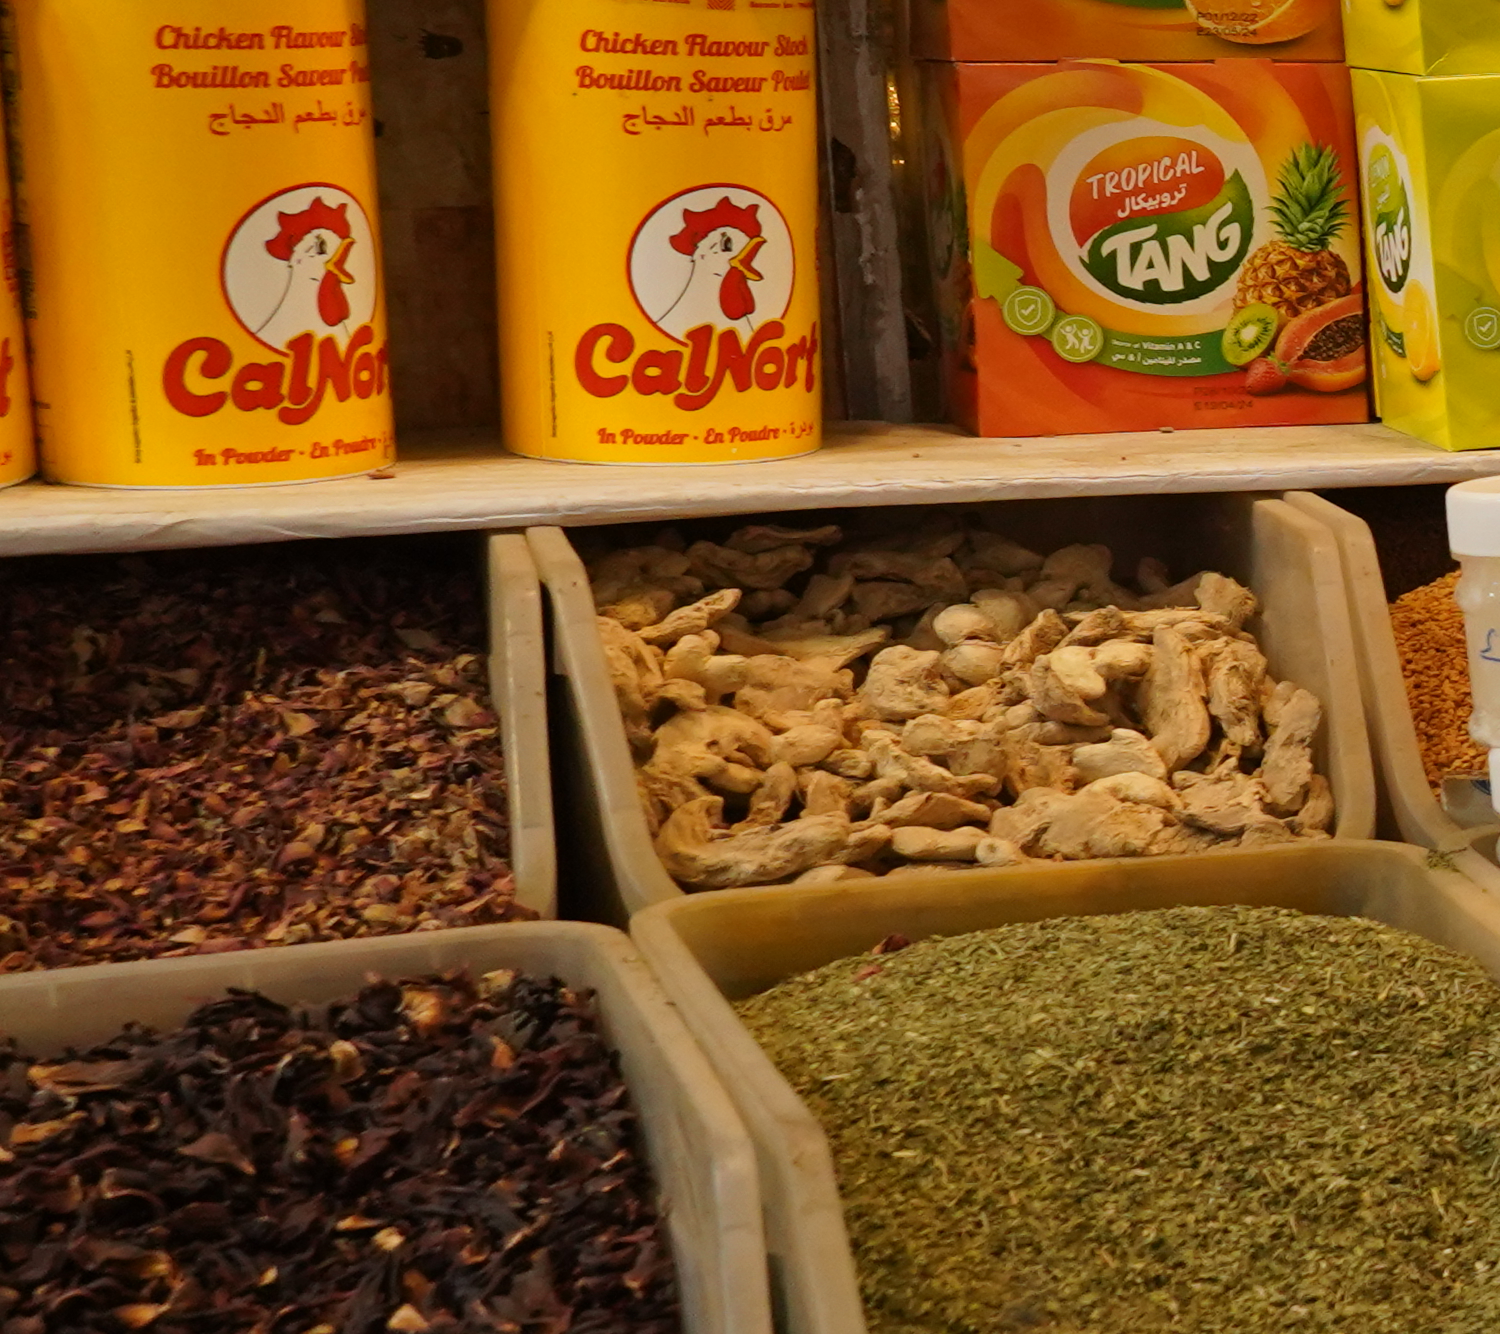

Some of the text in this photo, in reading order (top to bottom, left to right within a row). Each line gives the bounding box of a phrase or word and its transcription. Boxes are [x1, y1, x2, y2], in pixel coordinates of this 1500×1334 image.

[156, 25, 264, 50] Chicken
[580, 30, 679, 56] Chicken
[684, 33, 768, 57] Flavour
[151, 63, 346, 89] Bouillon Saveur
[576, 65, 767, 93] Bouillon Saveur
[1086, 150, 1205, 201] TROPICAL
[1116, 183, 1187, 219] تروبيكال
[1101, 202, 1241, 293] TANG
[1376, 206, 1410, 281] TANG
[575, 321, 818, 412] CalNort
[621, 428, 688, 446] Powder
[728, 425, 780, 443] Poudre
[220, 446, 295, 466] Powder
